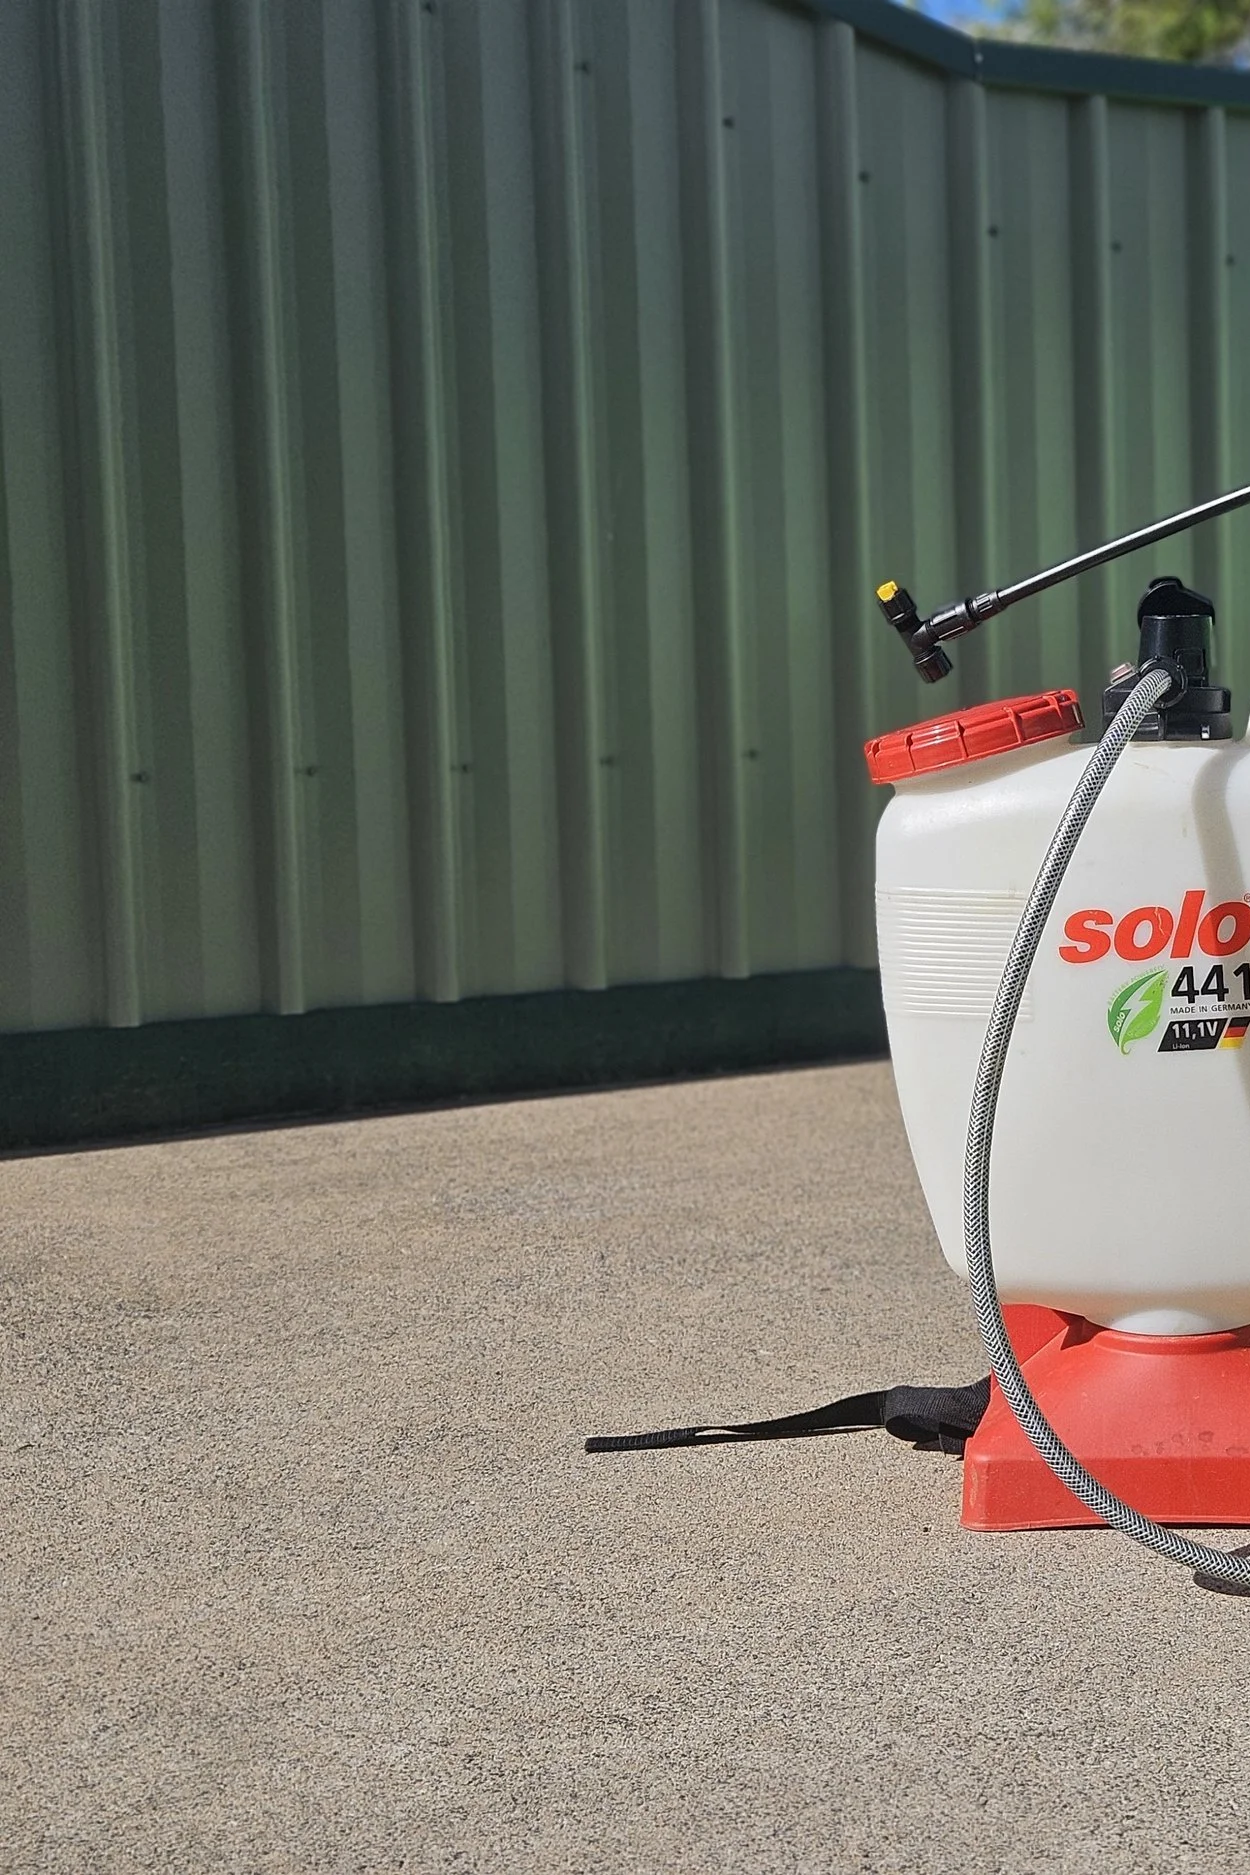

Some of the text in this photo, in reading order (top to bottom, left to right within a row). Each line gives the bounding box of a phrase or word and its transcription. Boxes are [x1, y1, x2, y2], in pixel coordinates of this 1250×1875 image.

[1170, 1006, 1196, 1014] MADE
[1113, 1011, 1126, 1033] solo
[1171, 1021, 1218, 1040] 11,1V
